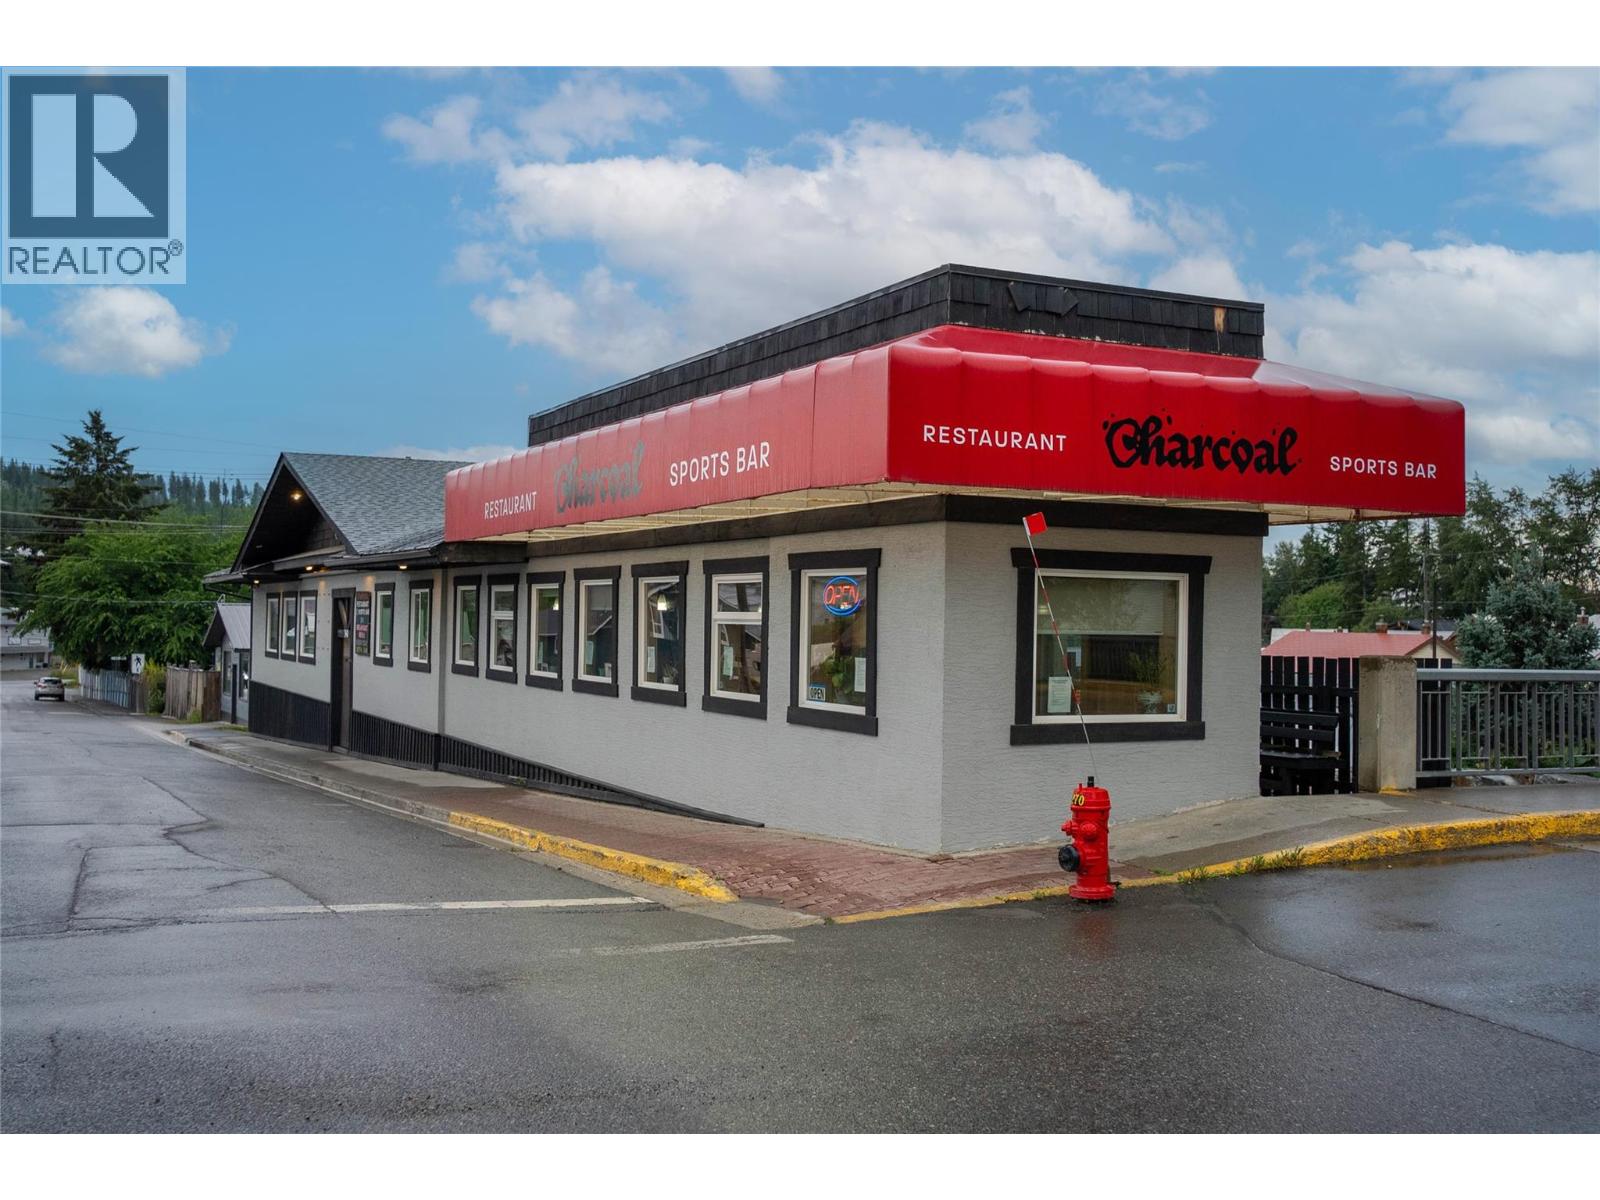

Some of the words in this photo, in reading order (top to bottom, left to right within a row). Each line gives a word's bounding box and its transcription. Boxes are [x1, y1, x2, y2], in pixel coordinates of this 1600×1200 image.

[923, 424, 1067, 452] RESTAURANT
[1103, 414, 1299, 476] Charcoal
[669, 451, 729, 487] SPORTS
[736, 441, 770, 473] BAR
[1330, 456, 1398, 476] SPORTS
[1404, 462, 1437, 479] BAR
[484, 491, 537, 520] RESTAURANT
[824, 585, 859, 605] OPEN
[810, 687, 825, 699] OPEN
